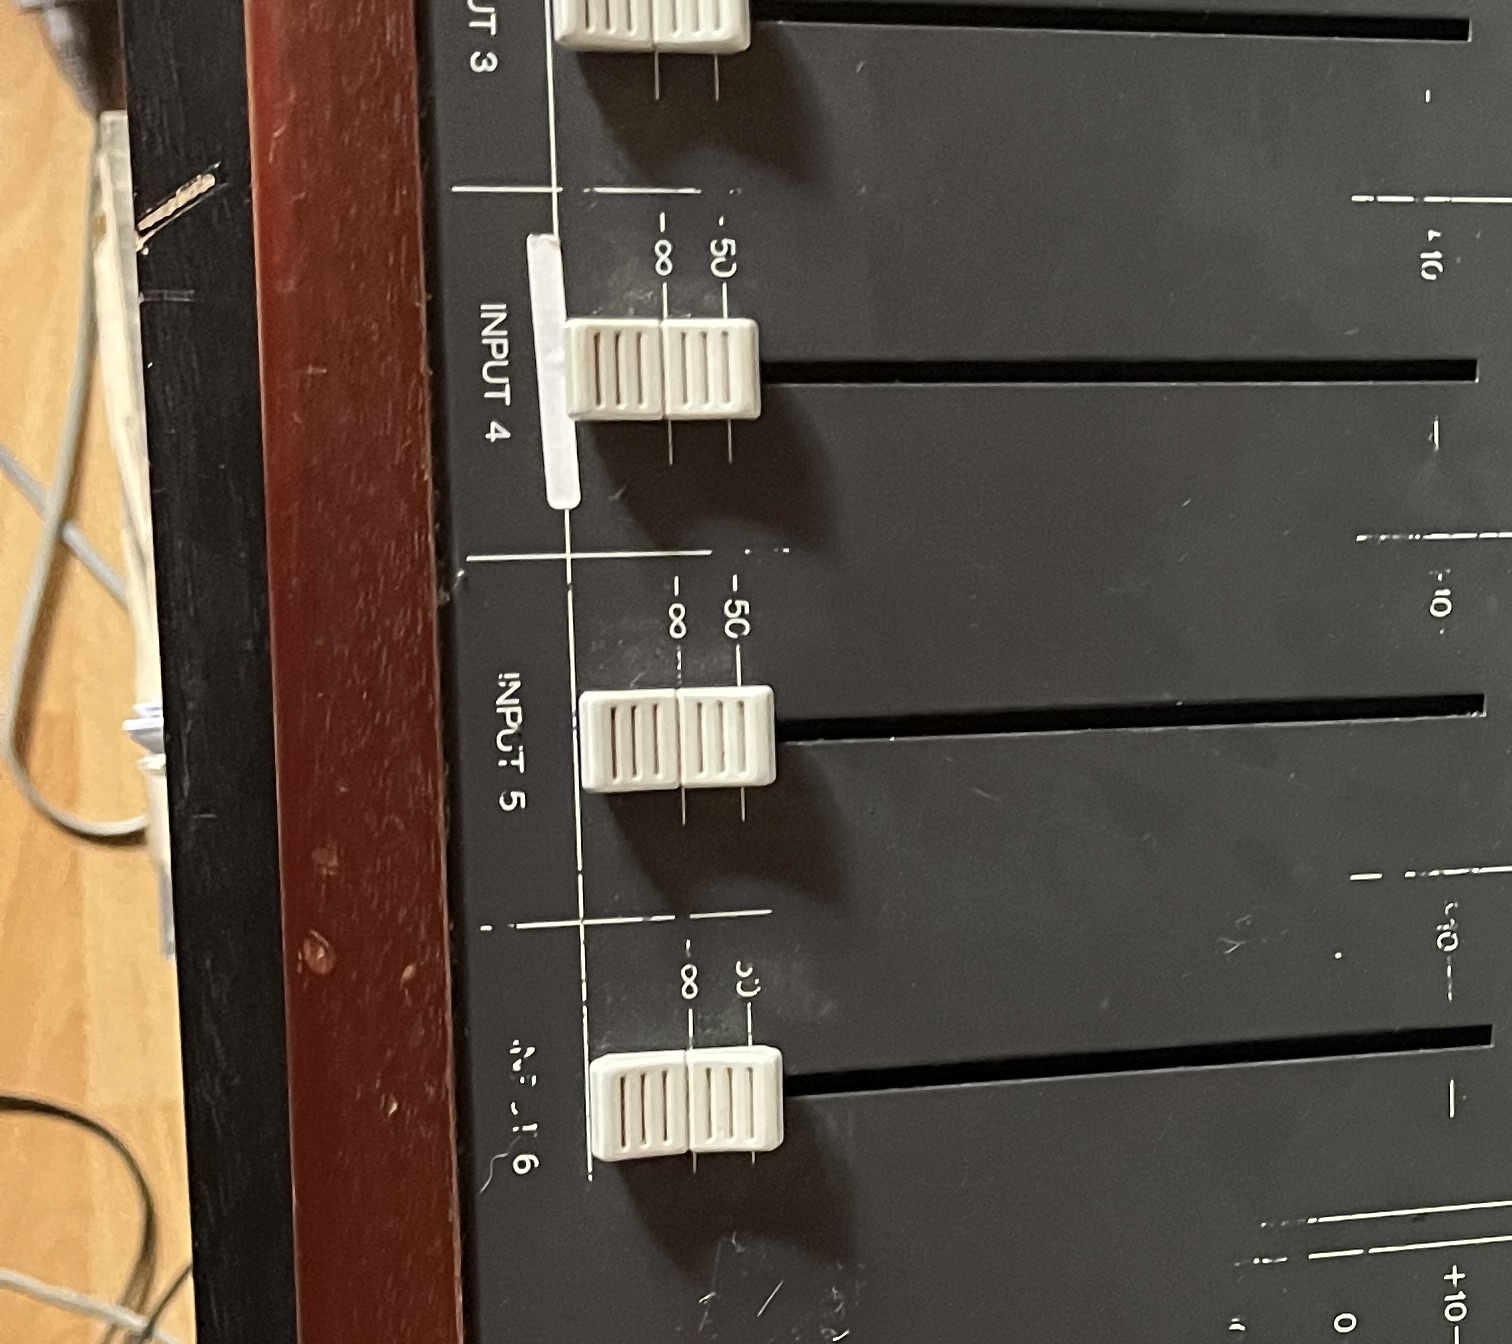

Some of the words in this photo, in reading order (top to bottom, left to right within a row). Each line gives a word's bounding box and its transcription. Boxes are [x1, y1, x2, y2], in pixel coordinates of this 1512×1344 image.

[470, 52, 497, 72] 3
[481, 304, 510, 405] INPUT
[486, 421, 510, 442] 4
[496, 673, 524, 773] INPUT
[499, 791, 525, 810] 5
[513, 1155, 539, 1174] 6
[1444, 1265, 1467, 1321] +10
[1334, 1313, 1356, 1332] 0
